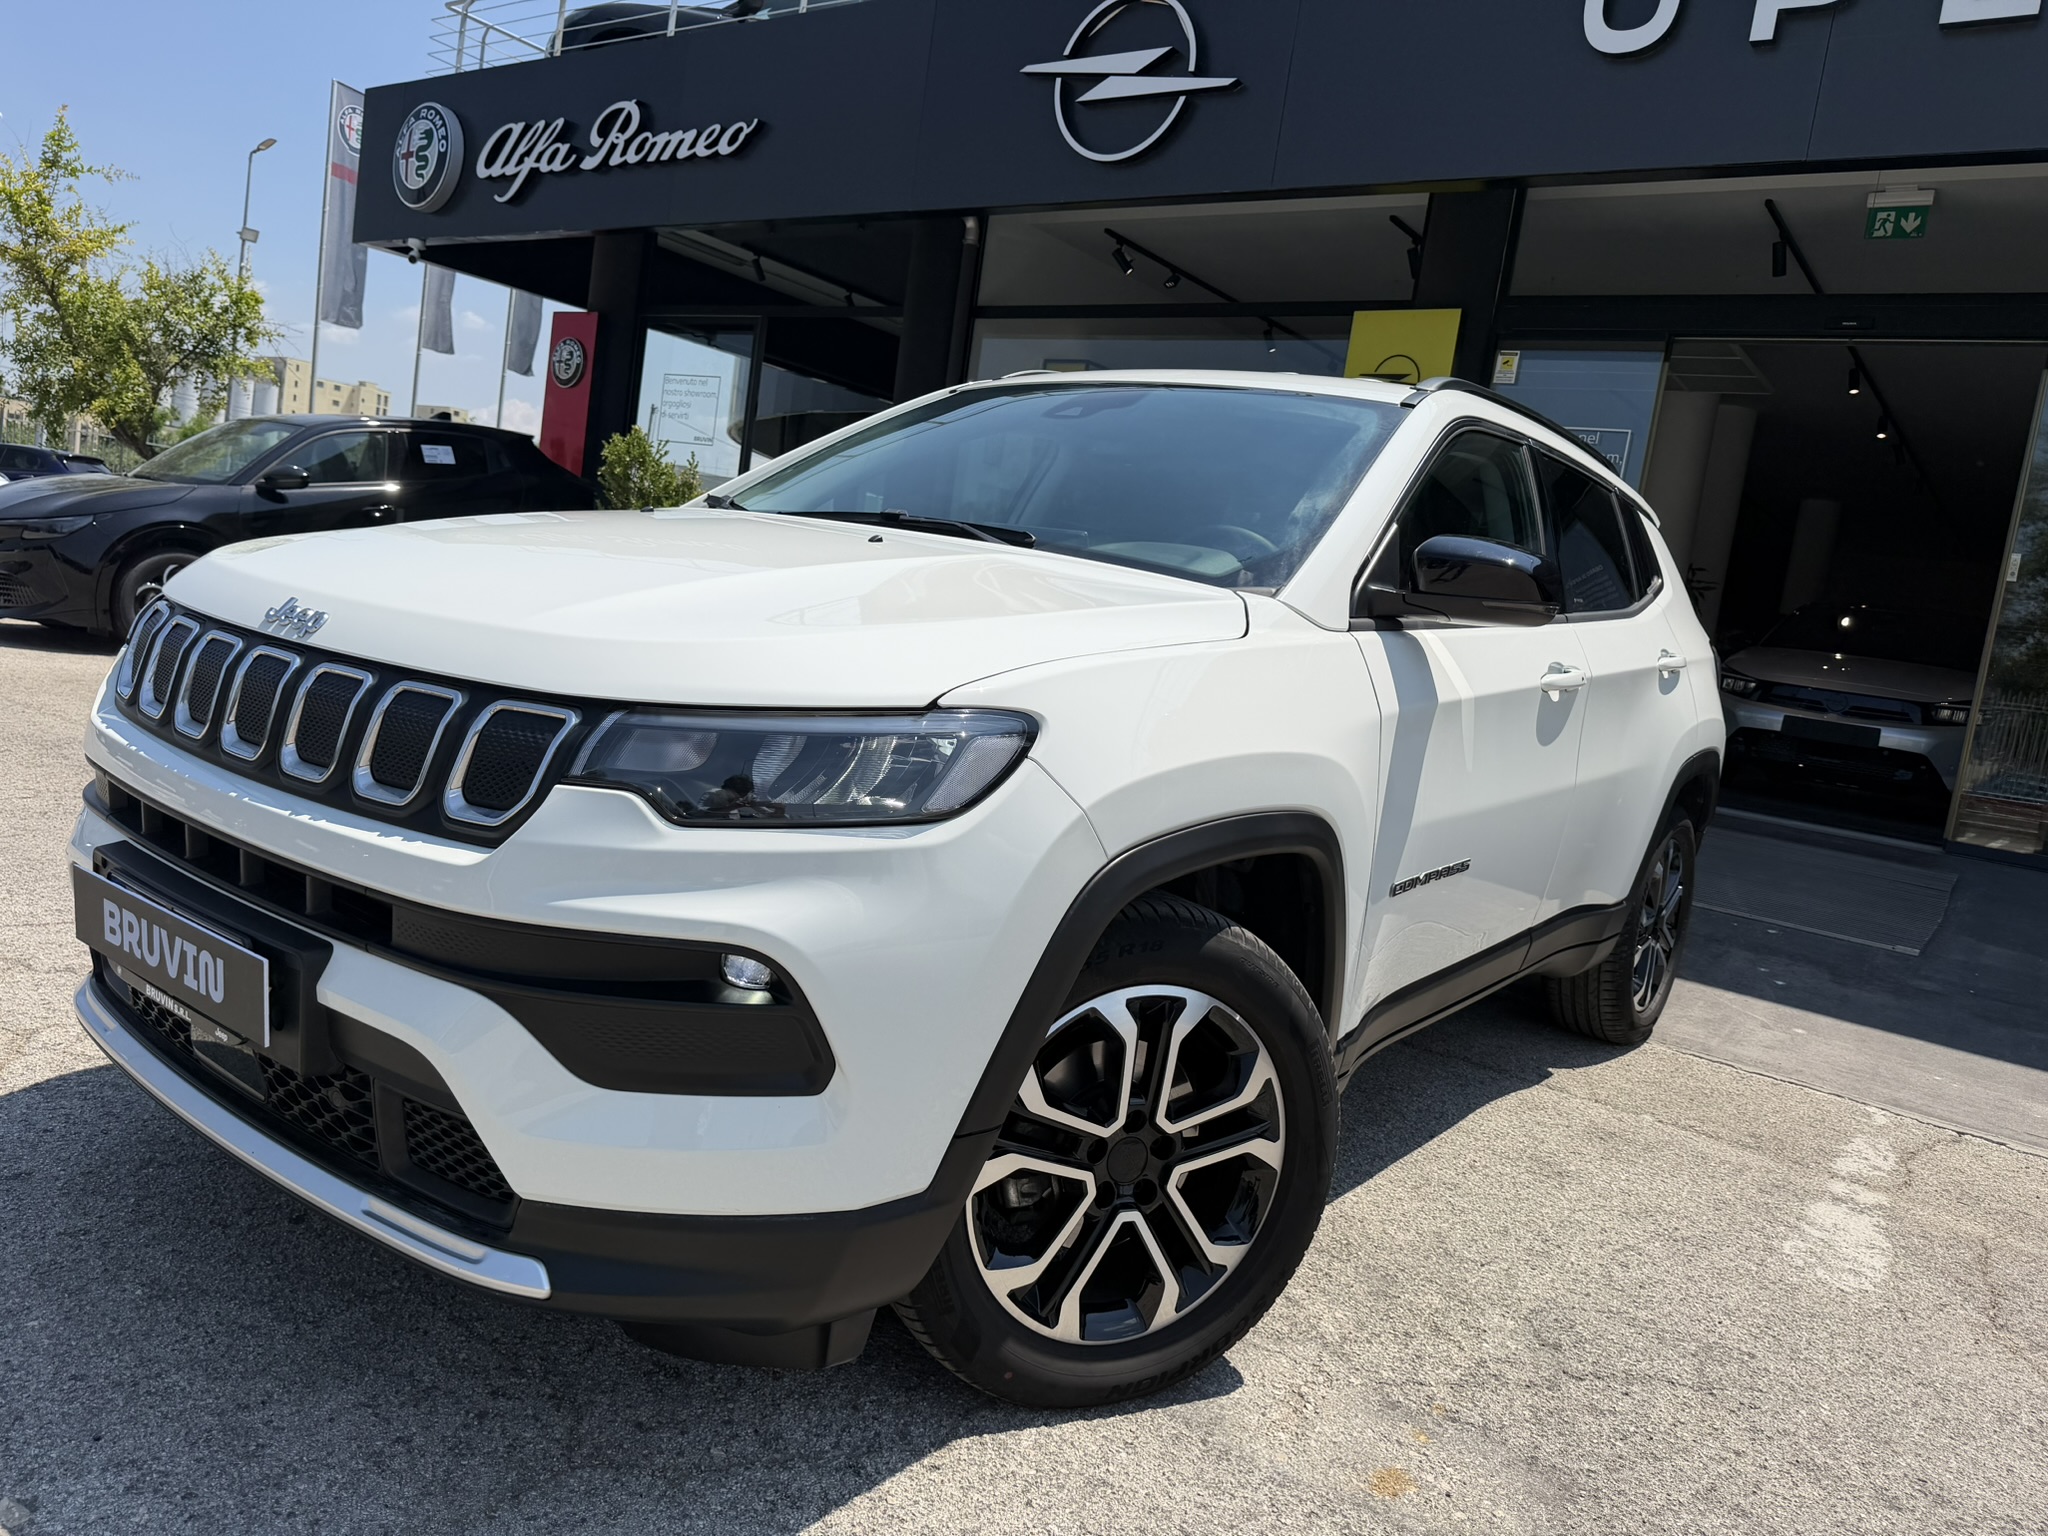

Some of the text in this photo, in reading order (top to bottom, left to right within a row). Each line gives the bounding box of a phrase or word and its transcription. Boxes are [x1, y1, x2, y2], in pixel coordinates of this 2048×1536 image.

[419, 107, 447, 153] ROMEO
[475, 98, 759, 203] Alfa Romeo
[264, 596, 329, 638] Jeep
[1388, 857, 1472, 898] COMPASS
[103, 897, 225, 1004] BRUVIN
[146, 983, 174, 1011] BRUVIN
